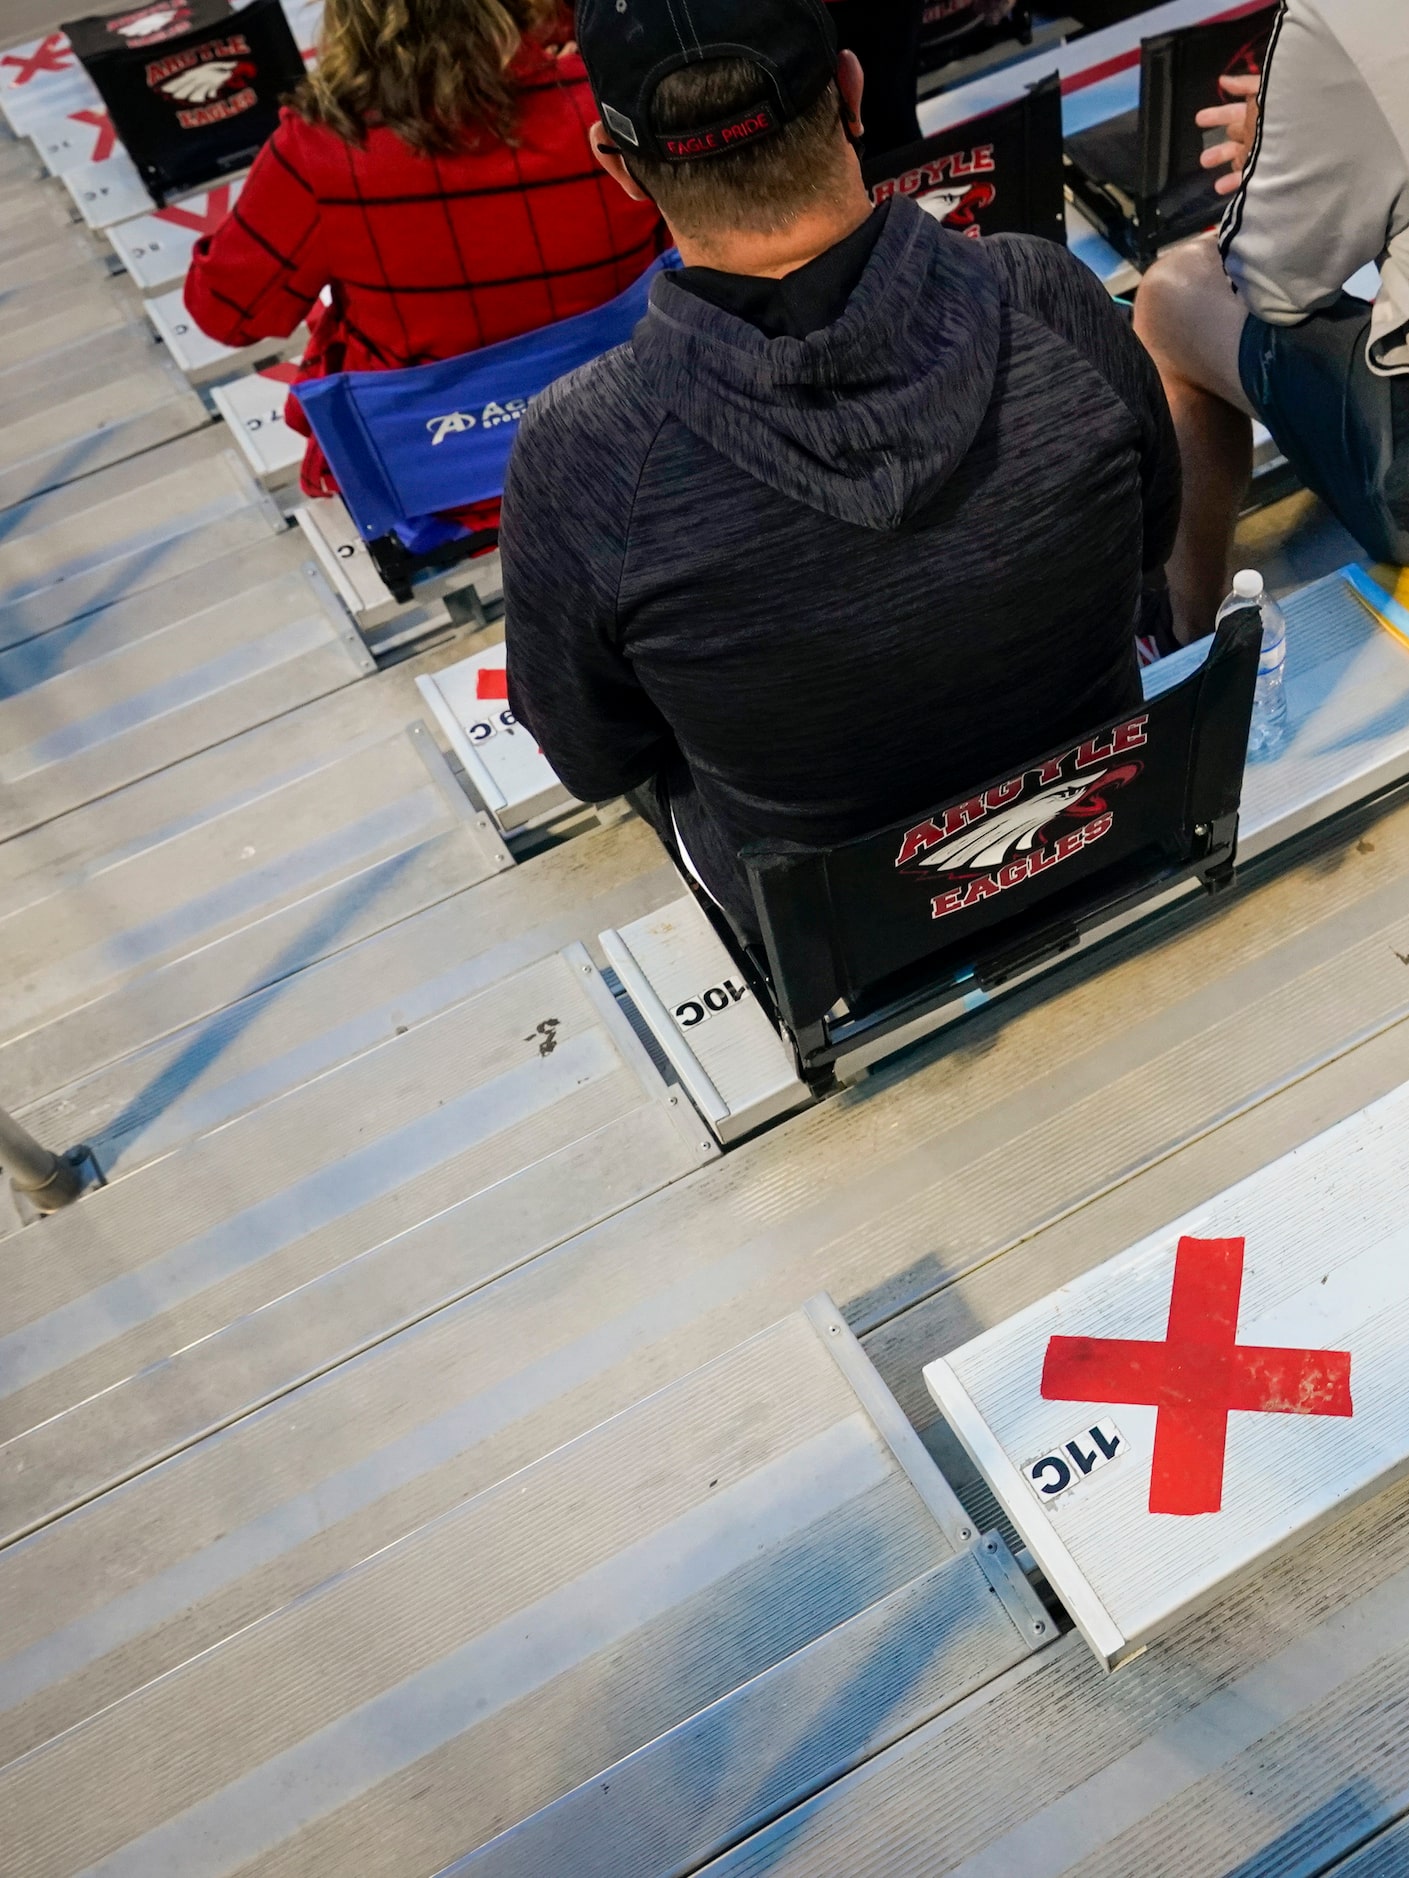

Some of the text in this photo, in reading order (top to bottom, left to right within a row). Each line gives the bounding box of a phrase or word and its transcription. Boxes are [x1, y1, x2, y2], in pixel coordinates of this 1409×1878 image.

[667, 113, 769, 155] EAGLE PRIDE
[868, 143, 996, 208] RGYLE
[895, 714, 1149, 868] ARGYLE
[931, 811, 1114, 919] EAGLES
[675, 979, 746, 1026] 10C
[1031, 1425, 1121, 1494] 11C
